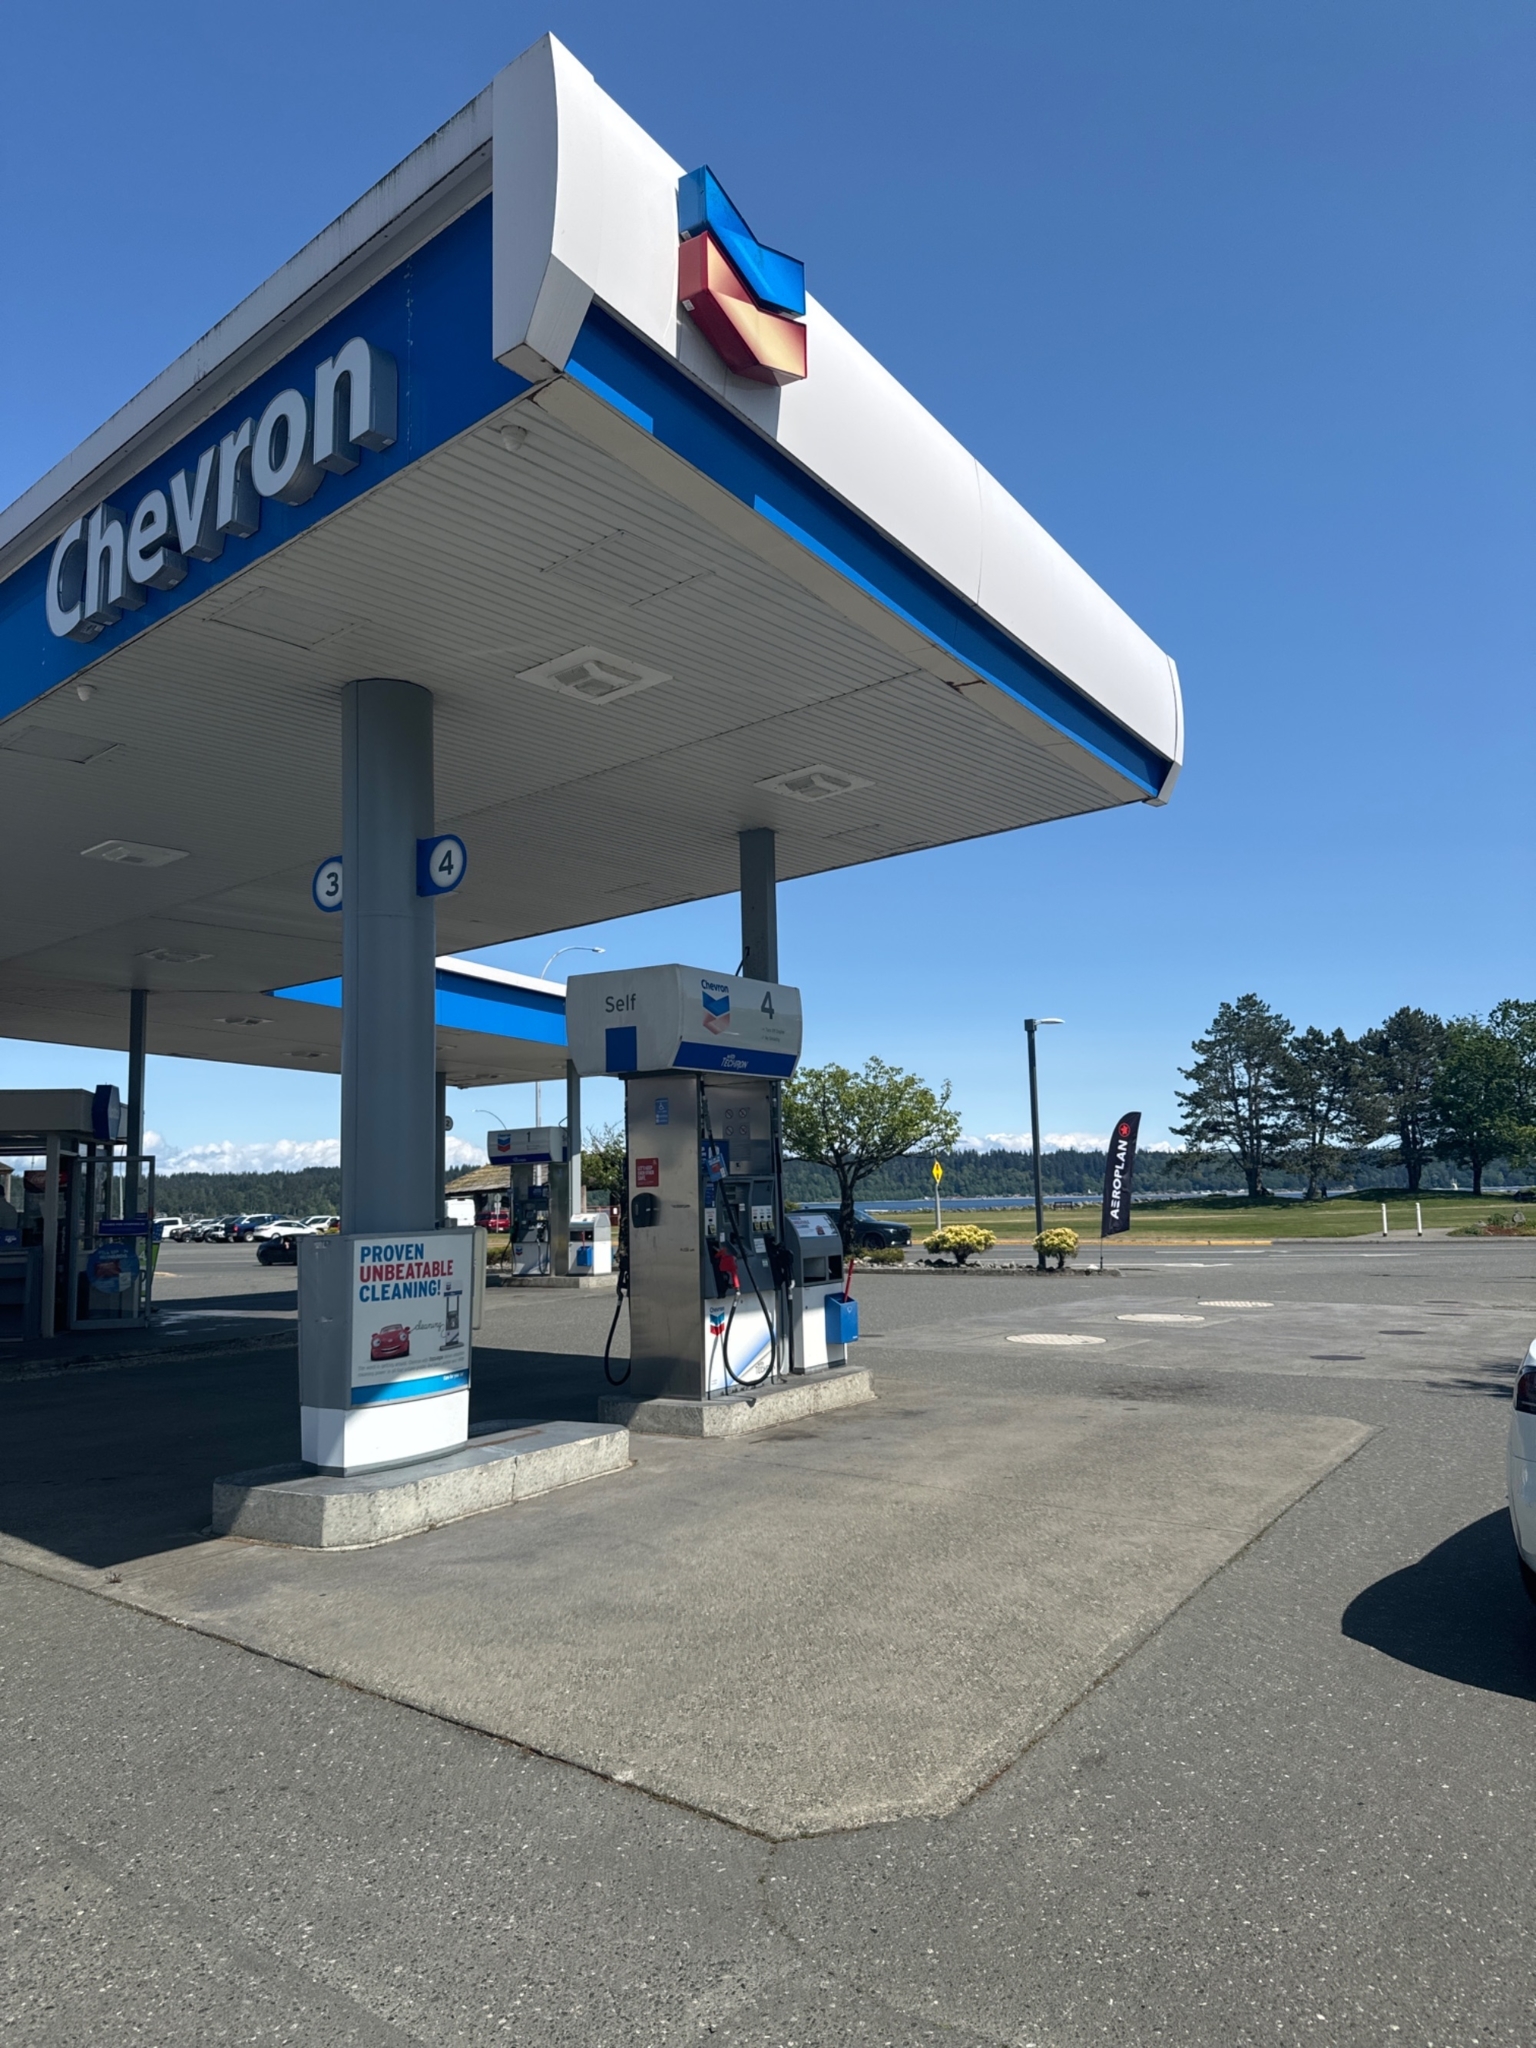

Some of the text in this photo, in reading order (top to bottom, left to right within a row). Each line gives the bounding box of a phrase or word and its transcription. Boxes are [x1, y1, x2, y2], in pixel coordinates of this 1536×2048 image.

[46, 337, 397, 642] Chevron
[438, 850, 454, 875] 4
[325, 872, 339, 896] 3
[701, 979, 729, 993] Chevron
[605, 993, 636, 1013] Self
[760, 991, 775, 1020] 4
[526, 1131, 531, 1143] 1
[1110, 1139, 1128, 1220] AEROPLAN
[360, 1243, 424, 1263] PROVEN
[359, 1260, 454, 1283] UNBEATABLE
[359, 1280, 441, 1302] CLEANING!
